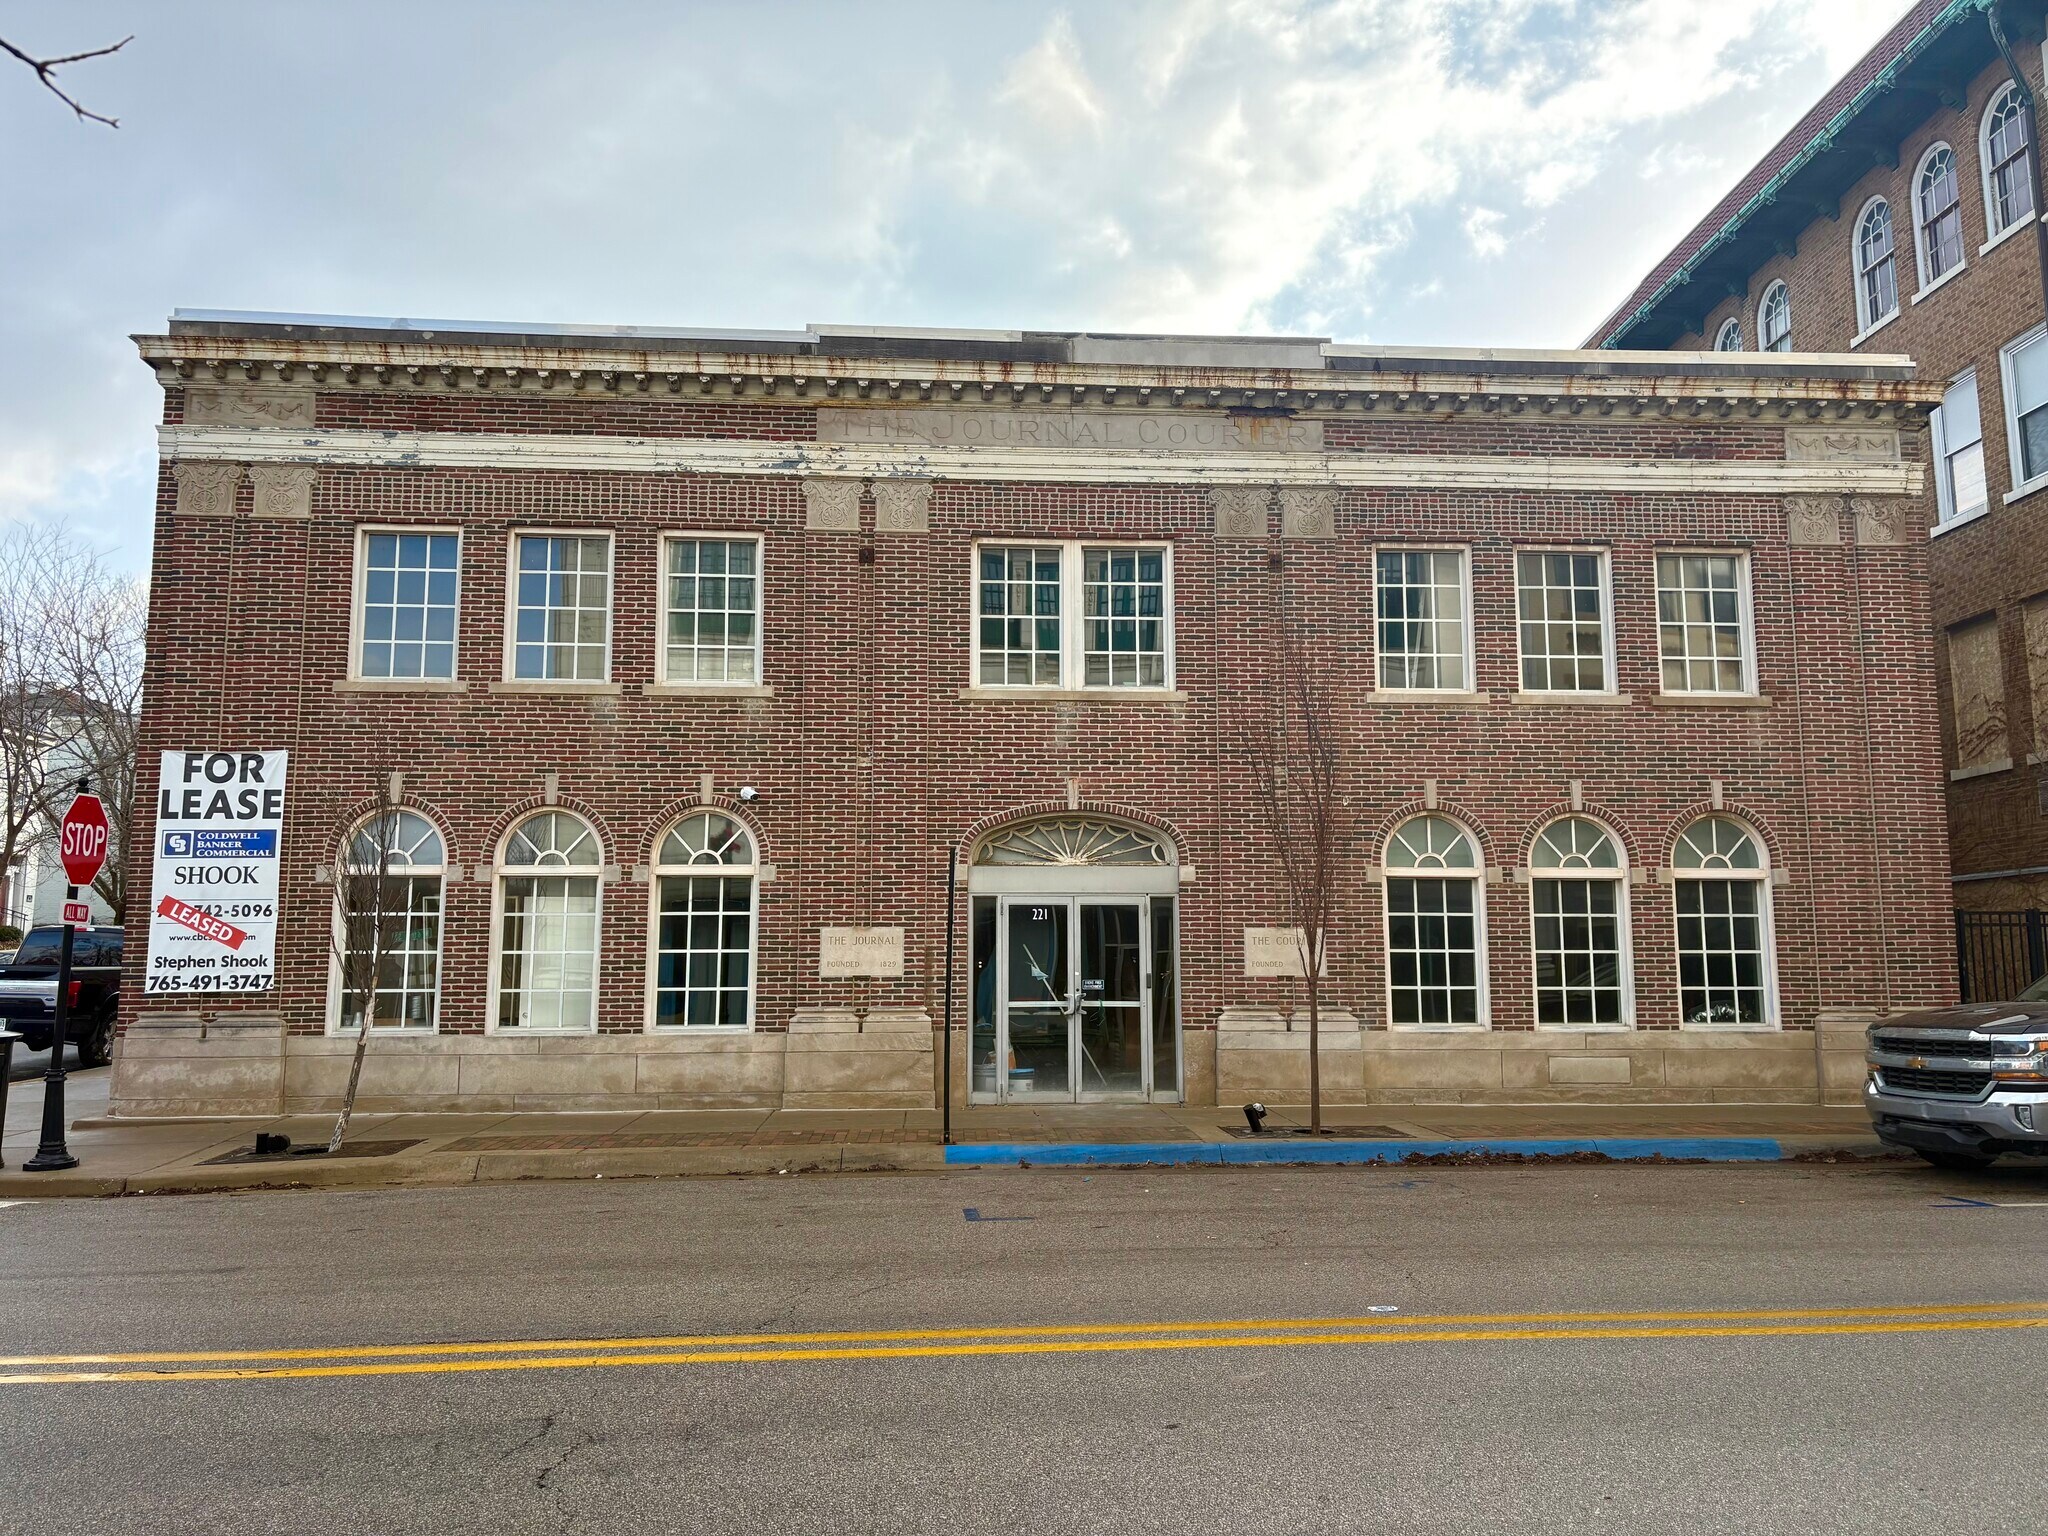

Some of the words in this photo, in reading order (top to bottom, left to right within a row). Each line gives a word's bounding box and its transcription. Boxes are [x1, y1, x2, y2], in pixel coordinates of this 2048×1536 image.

[832, 411, 917, 438] THE
[931, 414, 1123, 443] JOURNAL
[1137, 418, 1308, 447] COURIER
[183, 753, 265, 784] FOR
[160, 789, 282, 820] LEASE
[64, 821, 106, 857] STOP
[197, 832, 260, 840] COLDWELL
[196, 849, 272, 857] COMMERCIAL
[197, 841, 242, 849] BANKER
[174, 866, 259, 884] SHOOK
[65, 906, 75, 919] ALL
[77, 907, 88, 920] WAY
[1032, 908, 1048, 920] 221
[169, 903, 233, 941] LEASED
[829, 936, 847, 945] THE
[852, 936, 896, 946] JOURNAL
[1252, 937, 1270, 945] THE
[154, 955, 216, 971] Stephen
[221, 954, 269, 968] Shook
[149, 974, 273, 991] 765-491-3747
